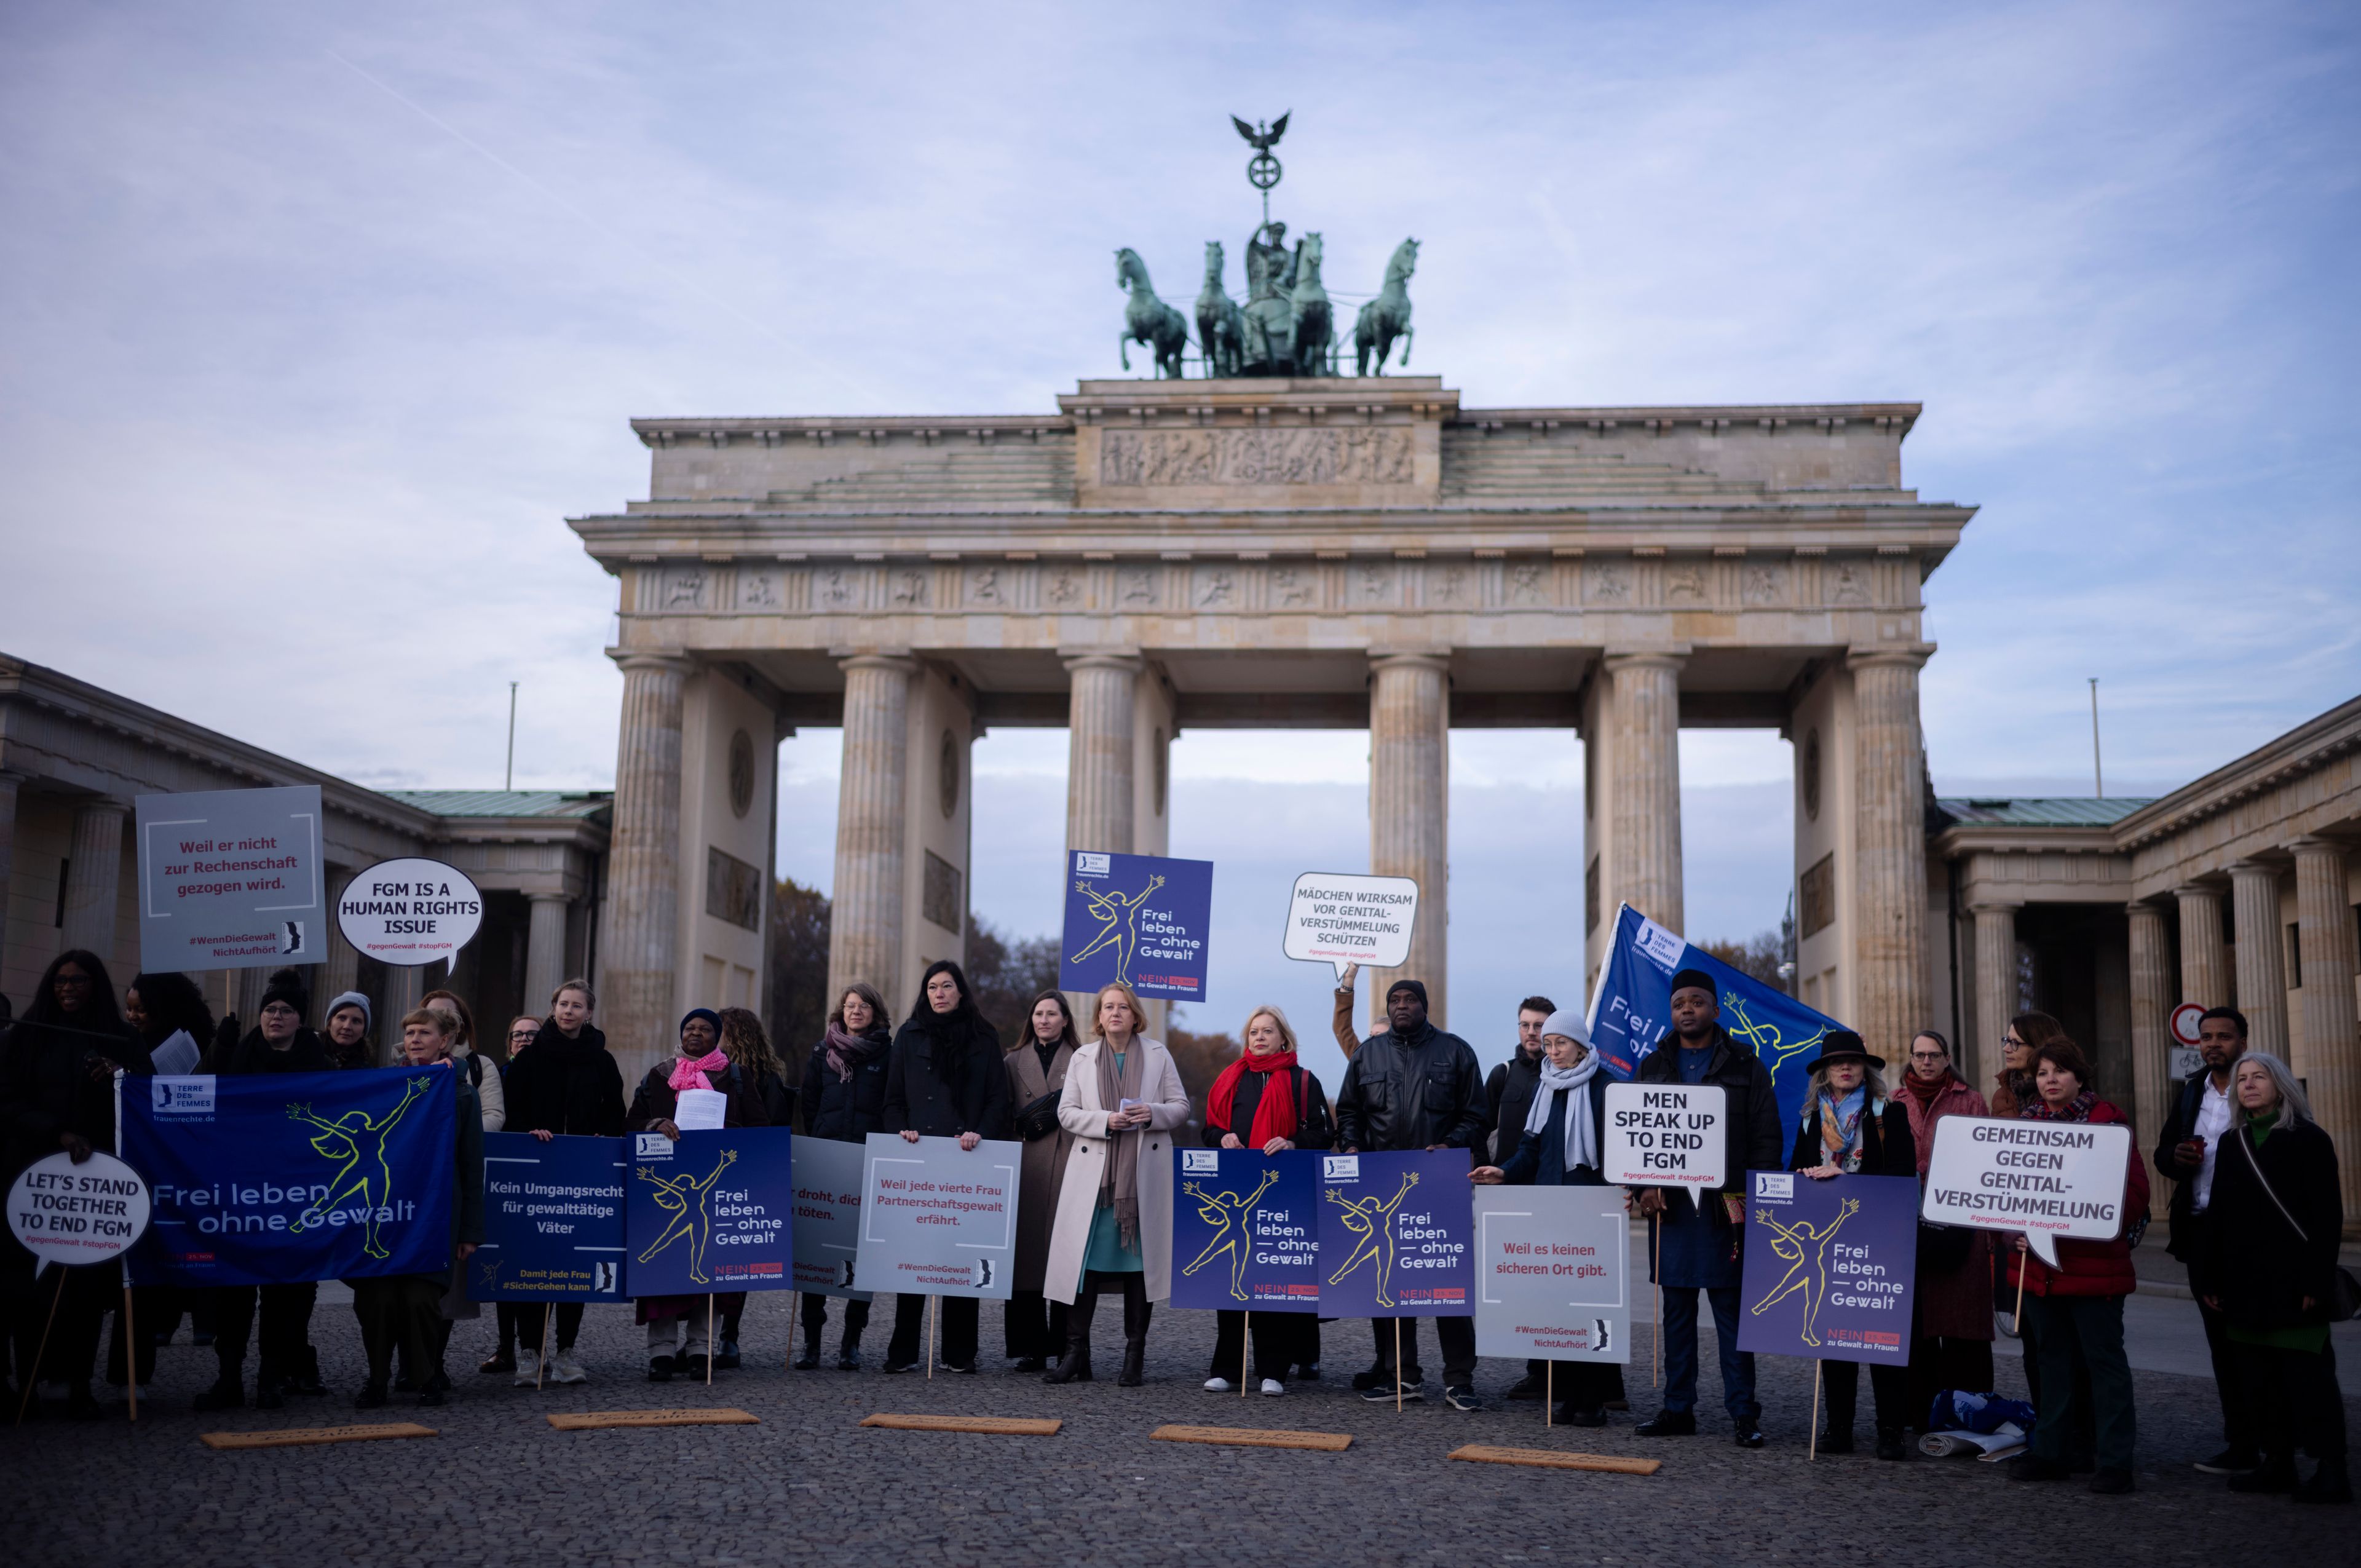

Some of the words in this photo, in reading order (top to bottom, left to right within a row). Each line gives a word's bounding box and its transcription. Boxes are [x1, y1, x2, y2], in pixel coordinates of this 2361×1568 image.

[180, 840, 213, 853] Weil
[218, 840, 234, 851] er
[239, 837, 277, 850] nicht
[165, 864, 189, 875] zur
[194, 857, 298, 873] Rechenschaft
[178, 882, 242, 897] gezogen
[247, 877, 285, 890] wird.
[373, 883, 409, 896] FGM
[415, 883, 433, 896] IS
[438, 883, 450, 896] A
[1297, 887, 1353, 901] MÄDCHEN
[1356, 892, 1412, 905] WIRKSAM
[342, 901, 407, 914] HUMAN
[414, 901, 478, 914] RIGHTS
[1313, 904, 1335, 914] VOR
[1339, 906, 1391, 917] GENITAL-
[1142, 909, 1172, 921] Frei
[384, 920, 436, 933] ISSUE
[1142, 921, 1185, 935] leben
[1300, 917, 1400, 933] VERSTÜMMELUNG
[189, 933, 276, 944] #WennDieGewalt
[1161, 935, 1200, 949] ohne
[1317, 932, 1376, 946] SCHÜTZEN
[213, 946, 277, 957] NichtAufhört
[1140, 946, 1193, 960] Gewalt
[1138, 973, 1168, 983] NEIN
[1610, 995, 1652, 1036] Frei
[1643, 1092, 1687, 1109] MEN
[1615, 1111, 1681, 1129] SPEAK
[1688, 1114, 1715, 1130] UP
[1626, 1131, 1654, 1148] TO
[1661, 1133, 1703, 1150] END
[1972, 1126, 2094, 1149] GEMEINSAM
[1643, 1152, 1686, 1170] FGM
[1996, 1150, 2063, 1170] GEGEN
[1623, 1172, 1675, 1181] #gegenGewalt
[1980, 1171, 2073, 1194] GENITAL-
[26, 1173, 74, 1191] LET'S
[79, 1177, 139, 1196] STAND
[489, 1181, 521, 1194] Kein
[524, 1182, 624, 1198] Umgangsrecht
[881, 1179, 906, 1189] Weil
[909, 1181, 935, 1192] jede
[939, 1182, 972, 1194] vierte
[976, 1185, 1002, 1195] Frau
[153, 1183, 220, 1206] Frei
[232, 1182, 330, 1205] leben
[715, 1189, 748, 1202] Frei
[798, 1188, 835, 1205] droht,
[31, 1194, 127, 1216] TOGETHER
[502, 1201, 523, 1213] für
[526, 1203, 614, 1218] gewalttätige
[715, 1203, 765, 1216] leben
[877, 1195, 1003, 1212] Partnerschaftsgewalt
[1934, 1189, 2114, 1221] VERSTÜMMELUNG
[198, 1210, 287, 1233] ohne
[300, 1200, 416, 1229] Gewalt
[798, 1206, 834, 1221] töten.
[916, 1214, 960, 1225] erfährt.
[1257, 1210, 1289, 1222] Frei
[1399, 1212, 1430, 1225] Frei
[20, 1213, 44, 1229] TO
[49, 1216, 87, 1232] END
[93, 1219, 132, 1237] FGM
[537, 1221, 574, 1233] Väter
[738, 1217, 782, 1230] ohne
[1970, 1214, 2027, 1226] #gegenGewalt
[2029, 1221, 2070, 1230] #stopFGM
[1257, 1223, 1304, 1237] leben
[1399, 1227, 1447, 1240] leben
[25, 1235, 80, 1246] #gegenGewalt
[82, 1240, 121, 1249] #stopFGM
[715, 1231, 775, 1245] Gewalt
[1278, 1238, 1319, 1251] ohne
[1422, 1241, 1464, 1254] ohne
[1503, 1243, 1530, 1254] Weil
[1534, 1246, 1548, 1254] es
[1552, 1243, 1595, 1256] keinen
[1834, 1243, 1869, 1259] Frei
[1256, 1252, 1314, 1265] Gewalt
[1400, 1255, 1458, 1269] Gewalt
[520, 1269, 548, 1278] Damit
[549, 1270, 569, 1280] jede
[571, 1270, 591, 1279] Frau
[715, 1264, 748, 1275] NEIN
[898, 1263, 971, 1274] #WennDieGewalt
[1497, 1262, 1548, 1274] sicheren
[1552, 1264, 1573, 1275] Ort
[1577, 1265, 1607, 1278] gibt.
[1833, 1259, 1885, 1276] leben
[502, 1281, 566, 1291] #SicherGehen
[568, 1283, 590, 1291] kann
[917, 1275, 970, 1286] NichtAufhört
[1856, 1278, 1904, 1294] ohne
[1255, 1284, 1286, 1294] NEIN
[1400, 1289, 1431, 1299] NEIN
[1831, 1292, 1895, 1309] Gewalt
[1515, 1326, 1588, 1336] #WennDieGewalt
[1827, 1328, 1862, 1341] NEIN
[1534, 1339, 1588, 1349] NichtAufhört
[1837, 1340, 1862, 1348] Gewalt
[1874, 1343, 1899, 1352] Frauen
